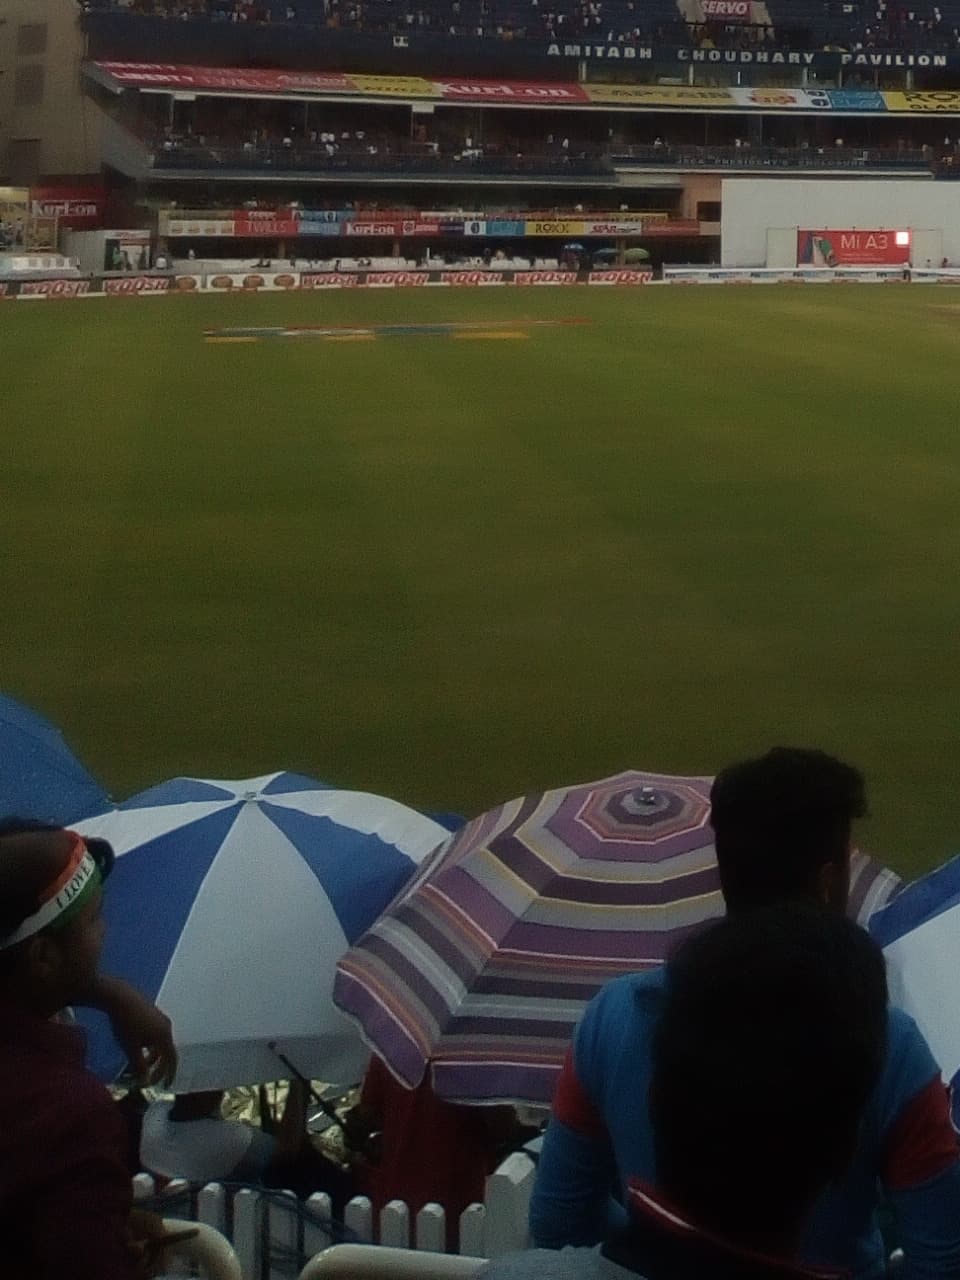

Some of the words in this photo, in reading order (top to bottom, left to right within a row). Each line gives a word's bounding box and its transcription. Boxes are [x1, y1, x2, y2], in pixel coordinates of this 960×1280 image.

[701, 0, 748, 16] SERVO
[546, 44, 653, 59] AMITABH
[677, 49, 815, 64] CHOUDHARY
[841, 54, 948, 67] PAVILION
[31, 200, 97, 217] Kurl-on
[345, 222, 396, 236] Kurl-on
[865, 235, 888, 249] A3
[64, 865, 91, 902] LOVE
